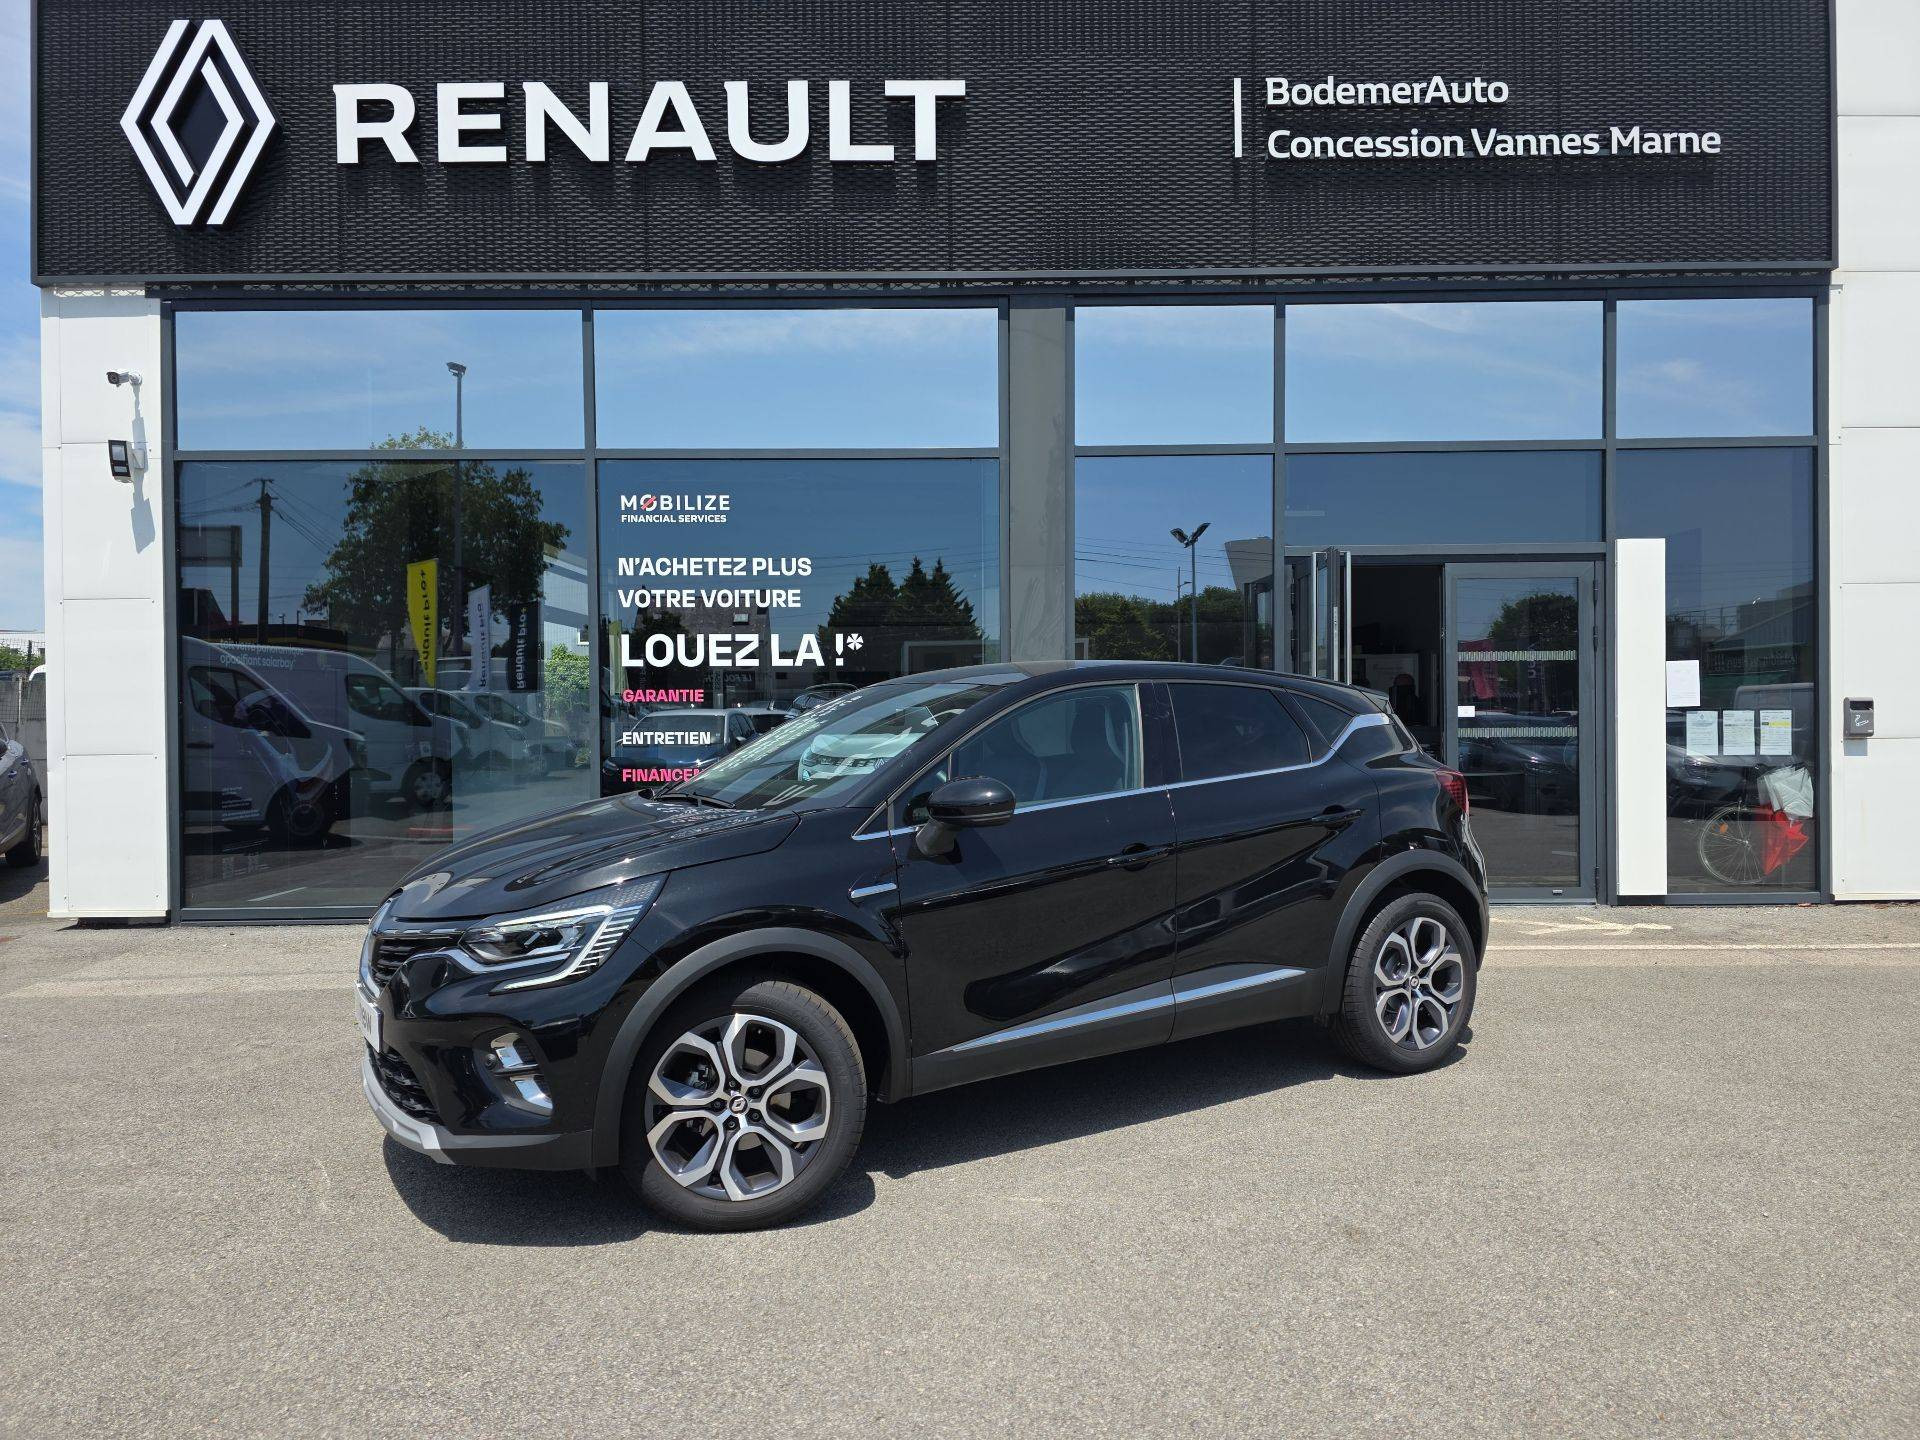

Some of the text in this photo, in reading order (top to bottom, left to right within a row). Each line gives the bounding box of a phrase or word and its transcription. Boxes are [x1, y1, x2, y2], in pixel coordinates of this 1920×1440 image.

[1266, 76, 1509, 105] BodemerAuto
[332, 80, 967, 164] RENAULT
[1267, 127, 1721, 158] Concession Vannes Marne
[620, 494, 730, 511] MOBILIZE
[621, 514, 727, 523] FINANCIAL SERVICES
[618, 557, 812, 576] N’ACHETEZ PLUS
[618, 589, 801, 608] VOTRE VOITURE
[621, 633, 760, 667] LOUEZ
[771, 634, 825, 667] LA
[622, 689, 705, 702] GARANTIE
[622, 731, 711, 745] ENTRETIEN
